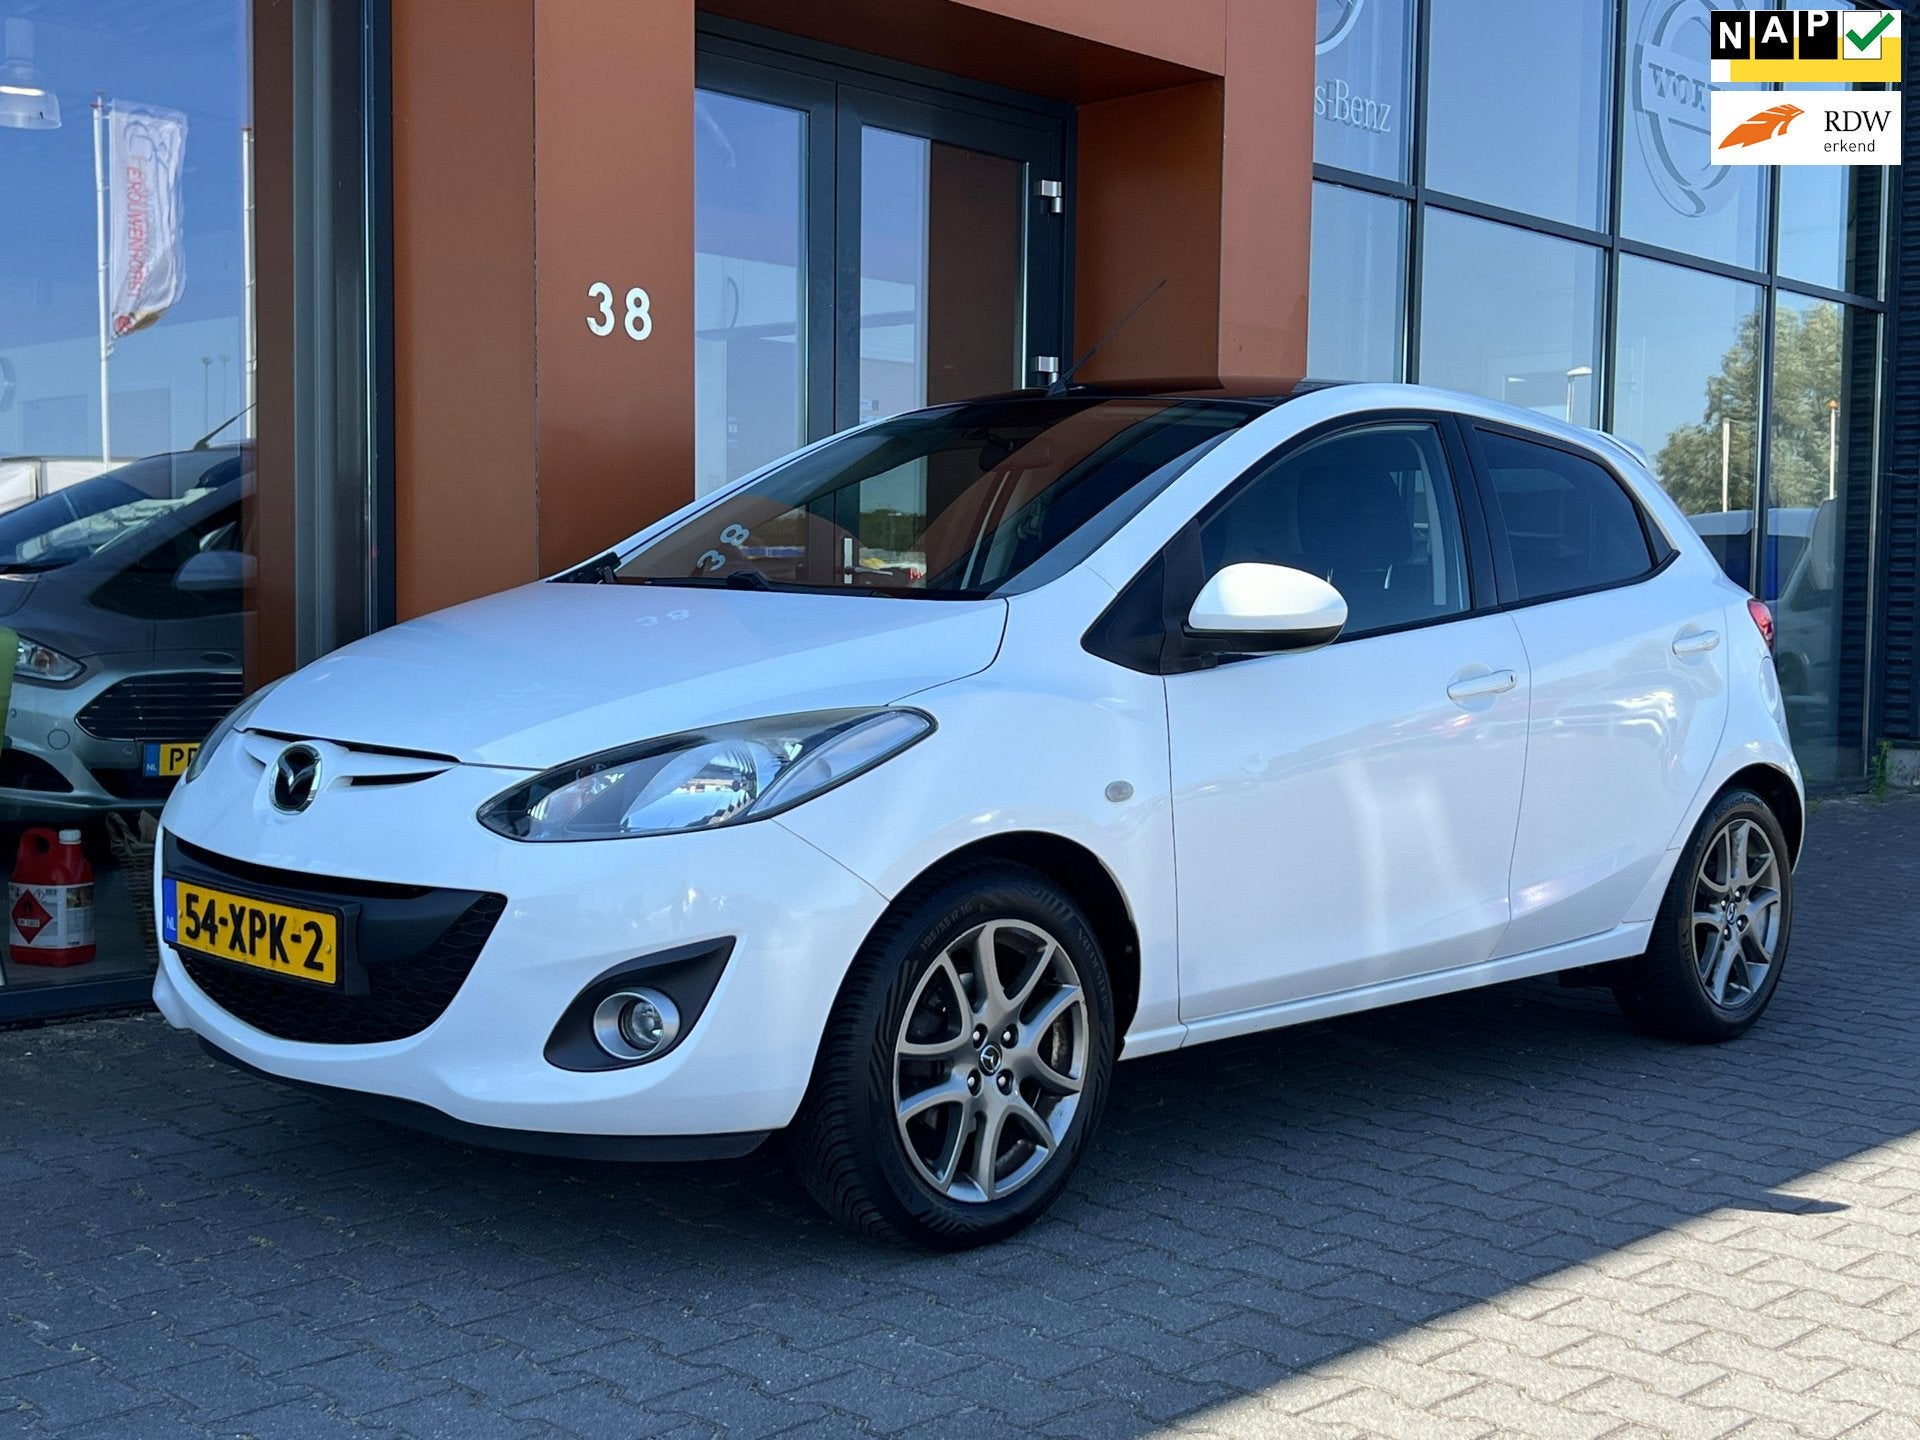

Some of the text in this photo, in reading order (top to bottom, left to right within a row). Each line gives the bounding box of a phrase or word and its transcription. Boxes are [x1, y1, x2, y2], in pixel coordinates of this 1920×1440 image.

[586, 281, 652, 341] 38
[146, 763, 158, 771] NL
[166, 915, 176, 931] NL
[185, 893, 324, 971] 54-XPK-2
